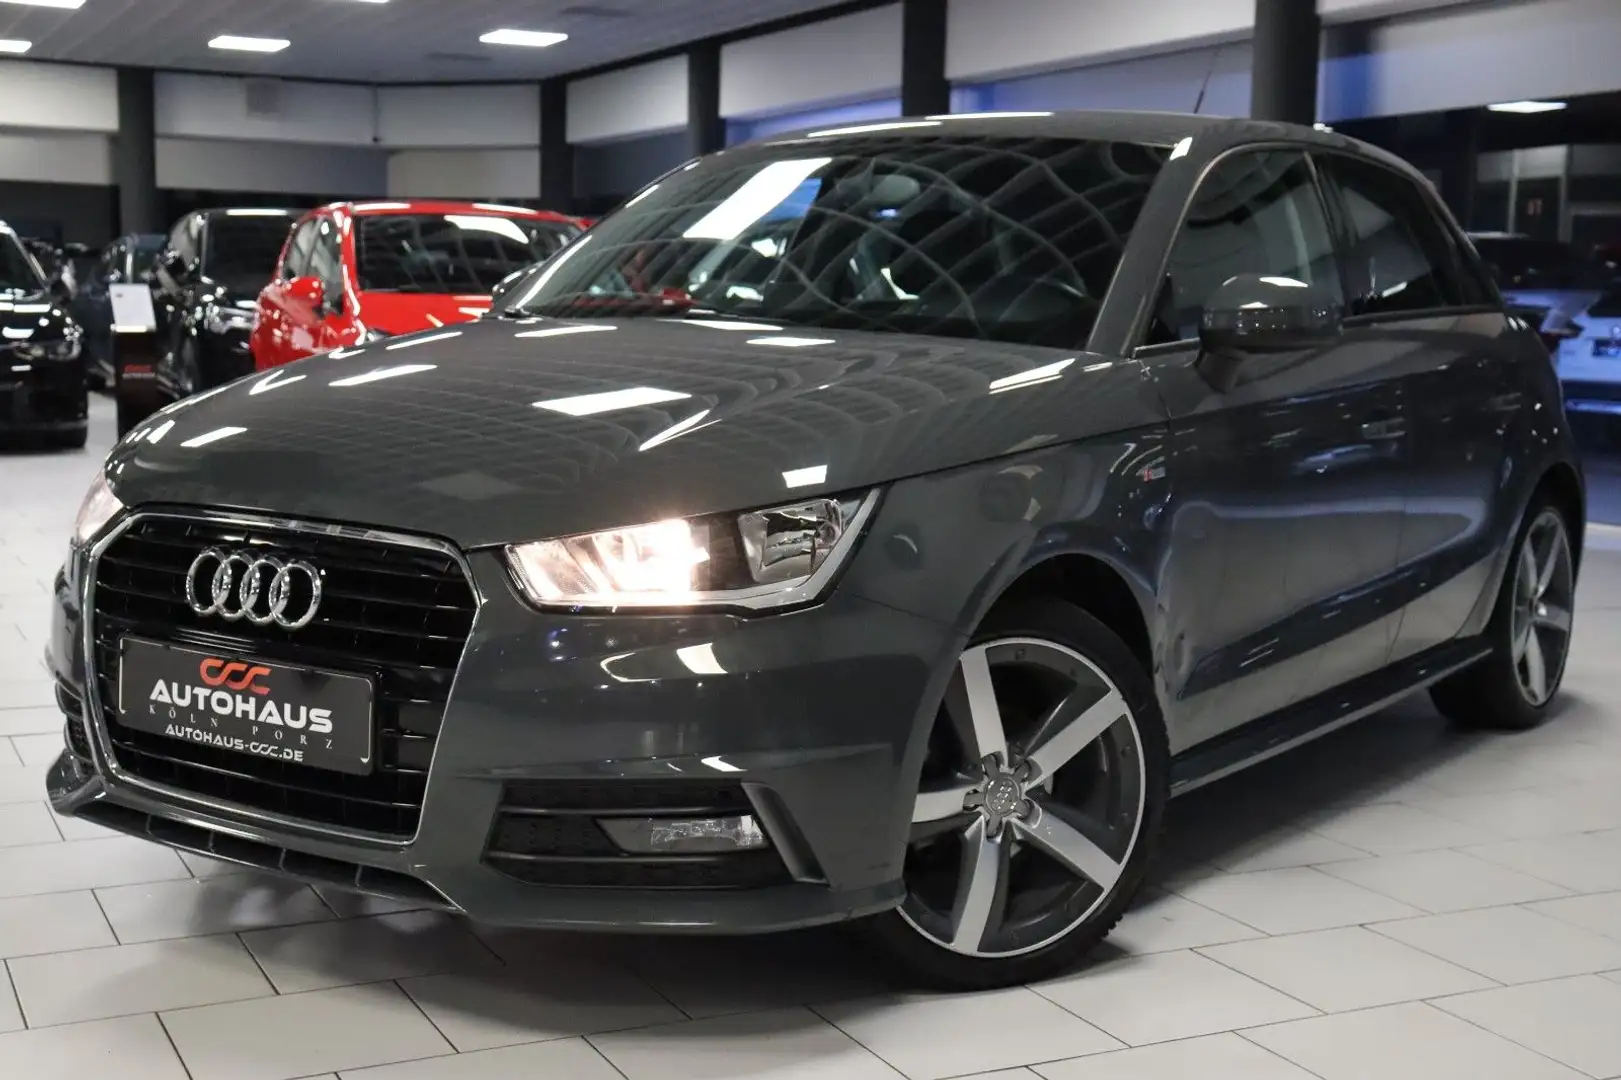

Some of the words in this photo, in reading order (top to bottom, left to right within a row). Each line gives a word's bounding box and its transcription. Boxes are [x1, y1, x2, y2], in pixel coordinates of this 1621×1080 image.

[149, 704, 219, 728] KÖLN
[251, 725, 333, 750] PORZ
[150, 678, 333, 733] AUTOHAUS
[165, 724, 304, 762] AUTOHAUS-CCC.DE
